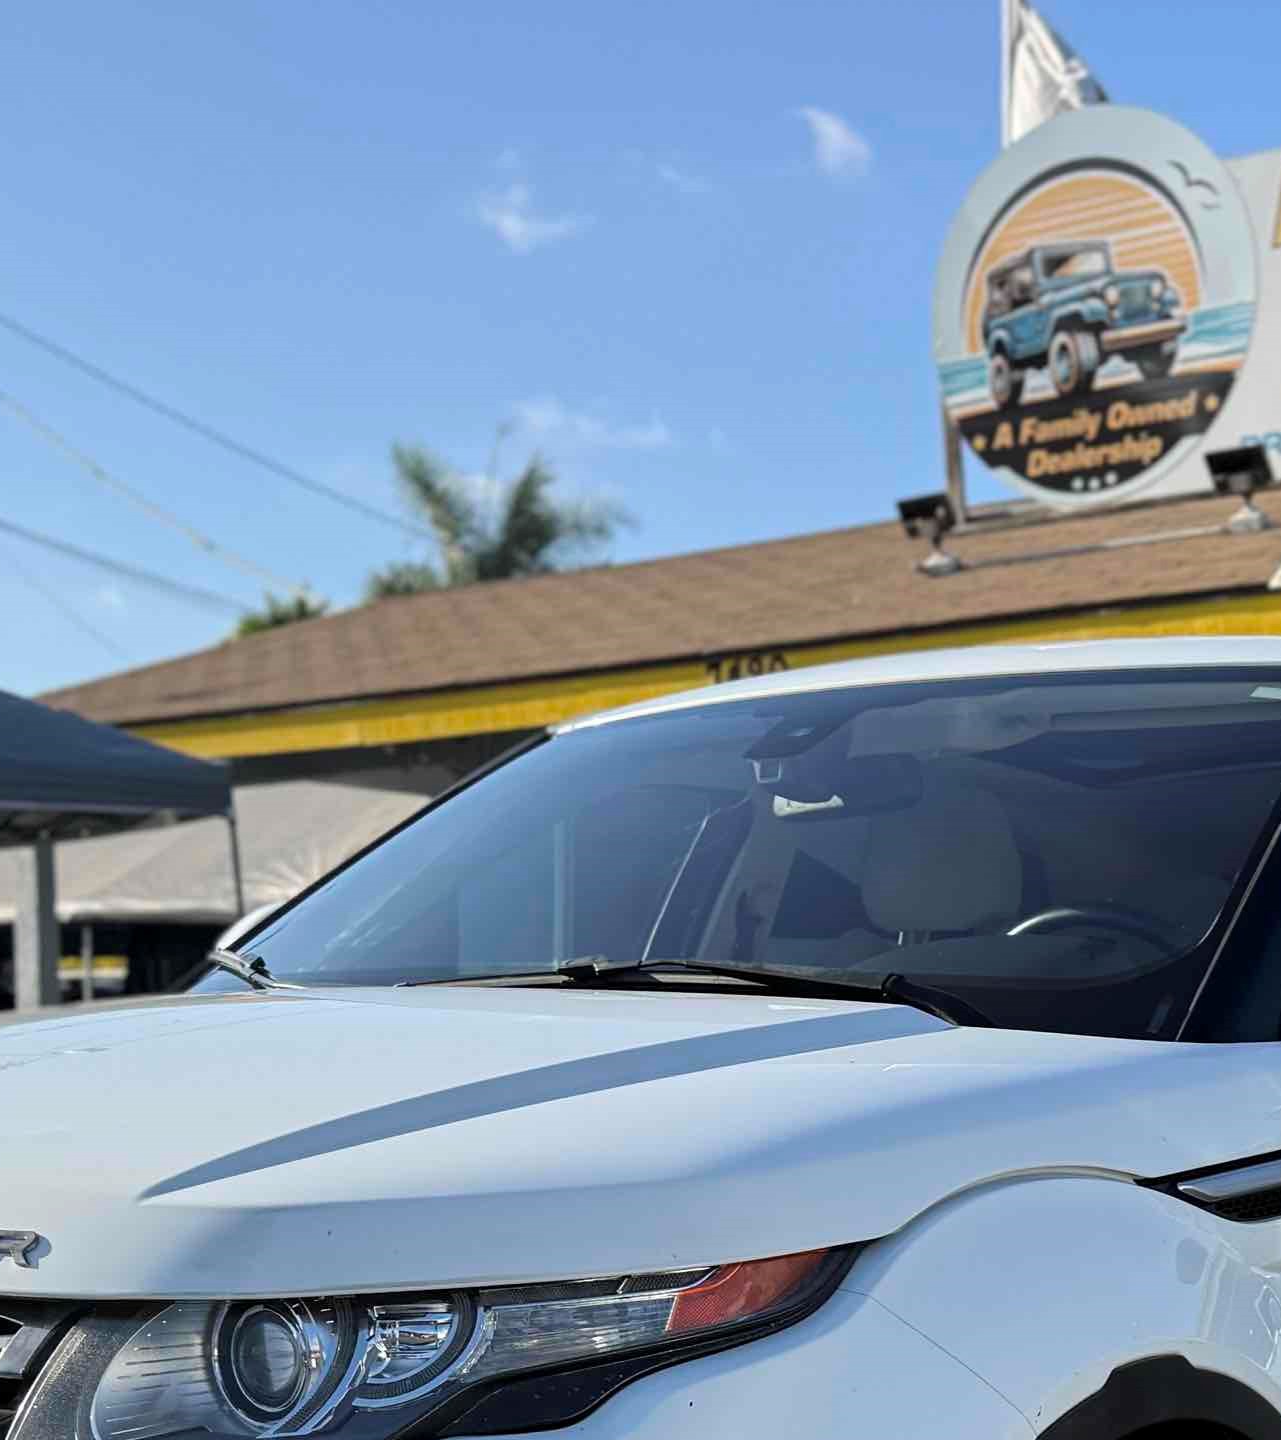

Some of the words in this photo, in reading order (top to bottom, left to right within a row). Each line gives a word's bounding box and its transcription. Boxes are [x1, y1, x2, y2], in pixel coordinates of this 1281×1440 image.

[992, 421, 1014, 449] A
[1021, 408, 1102, 444] Family
[1106, 390, 1198, 429] Owned
[1026, 433, 1164, 478] Dealership
